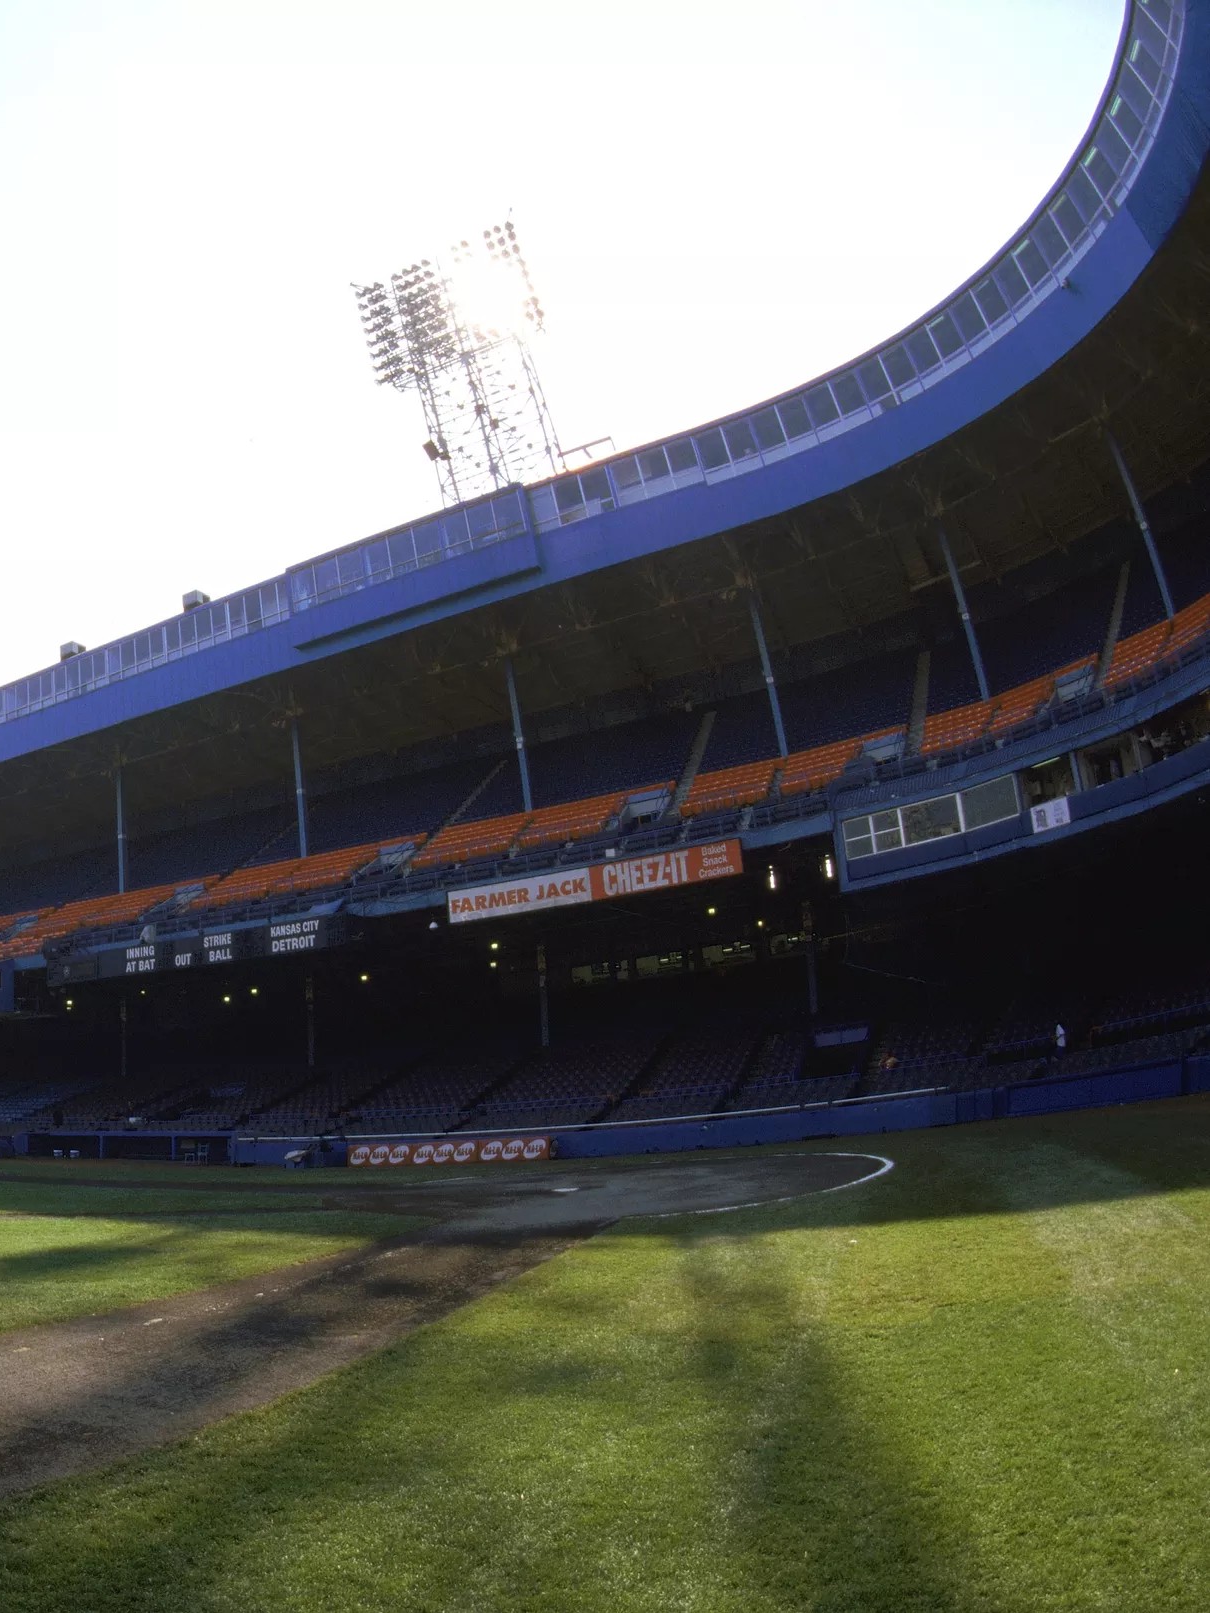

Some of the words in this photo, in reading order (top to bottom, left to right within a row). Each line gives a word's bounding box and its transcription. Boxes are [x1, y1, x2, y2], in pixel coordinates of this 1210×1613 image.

[701, 842, 727, 856] Baked
[702, 854, 728, 867] Snack
[602, 850, 689, 896] CHEEZ-IT
[698, 864, 735, 879] Crackers
[451, 886, 530, 914] FARMER
[536, 875, 586, 900] JACK
[270, 923, 302, 938] KANSAS
[302, 919, 320, 933] CITY
[203, 933, 232, 948] STRIKE
[271, 935, 316, 953] DETROIT
[126, 945, 155, 960] INNING
[175, 953, 192, 967] OUT
[208, 949, 232, 962] BALL
[125, 961, 138, 973] AT
[138, 958, 155, 972] BAT
